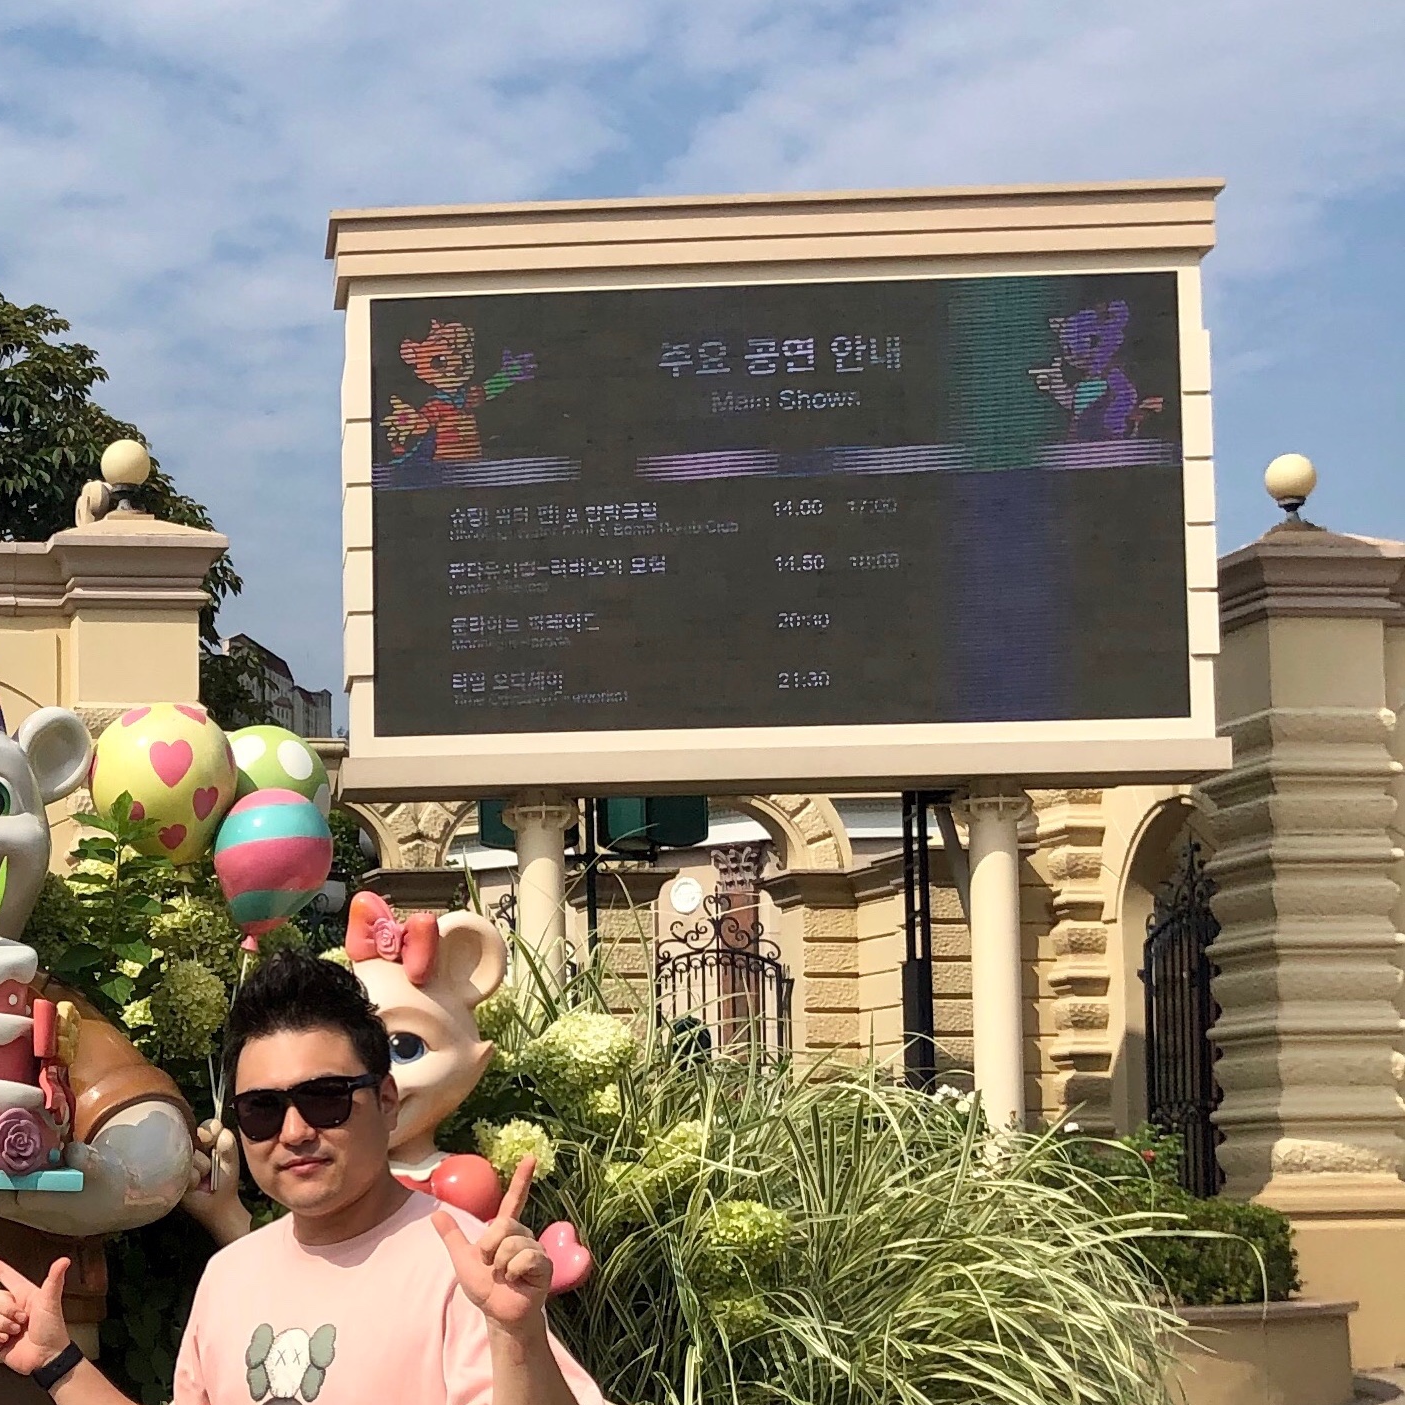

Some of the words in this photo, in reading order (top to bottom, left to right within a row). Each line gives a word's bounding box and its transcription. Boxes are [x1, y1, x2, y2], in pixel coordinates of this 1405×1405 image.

[658, 340, 731, 377] 주요
[744, 337, 815, 375] 공연
[830, 335, 901, 373] 안내
[778, 671, 830, 689] 21:30
